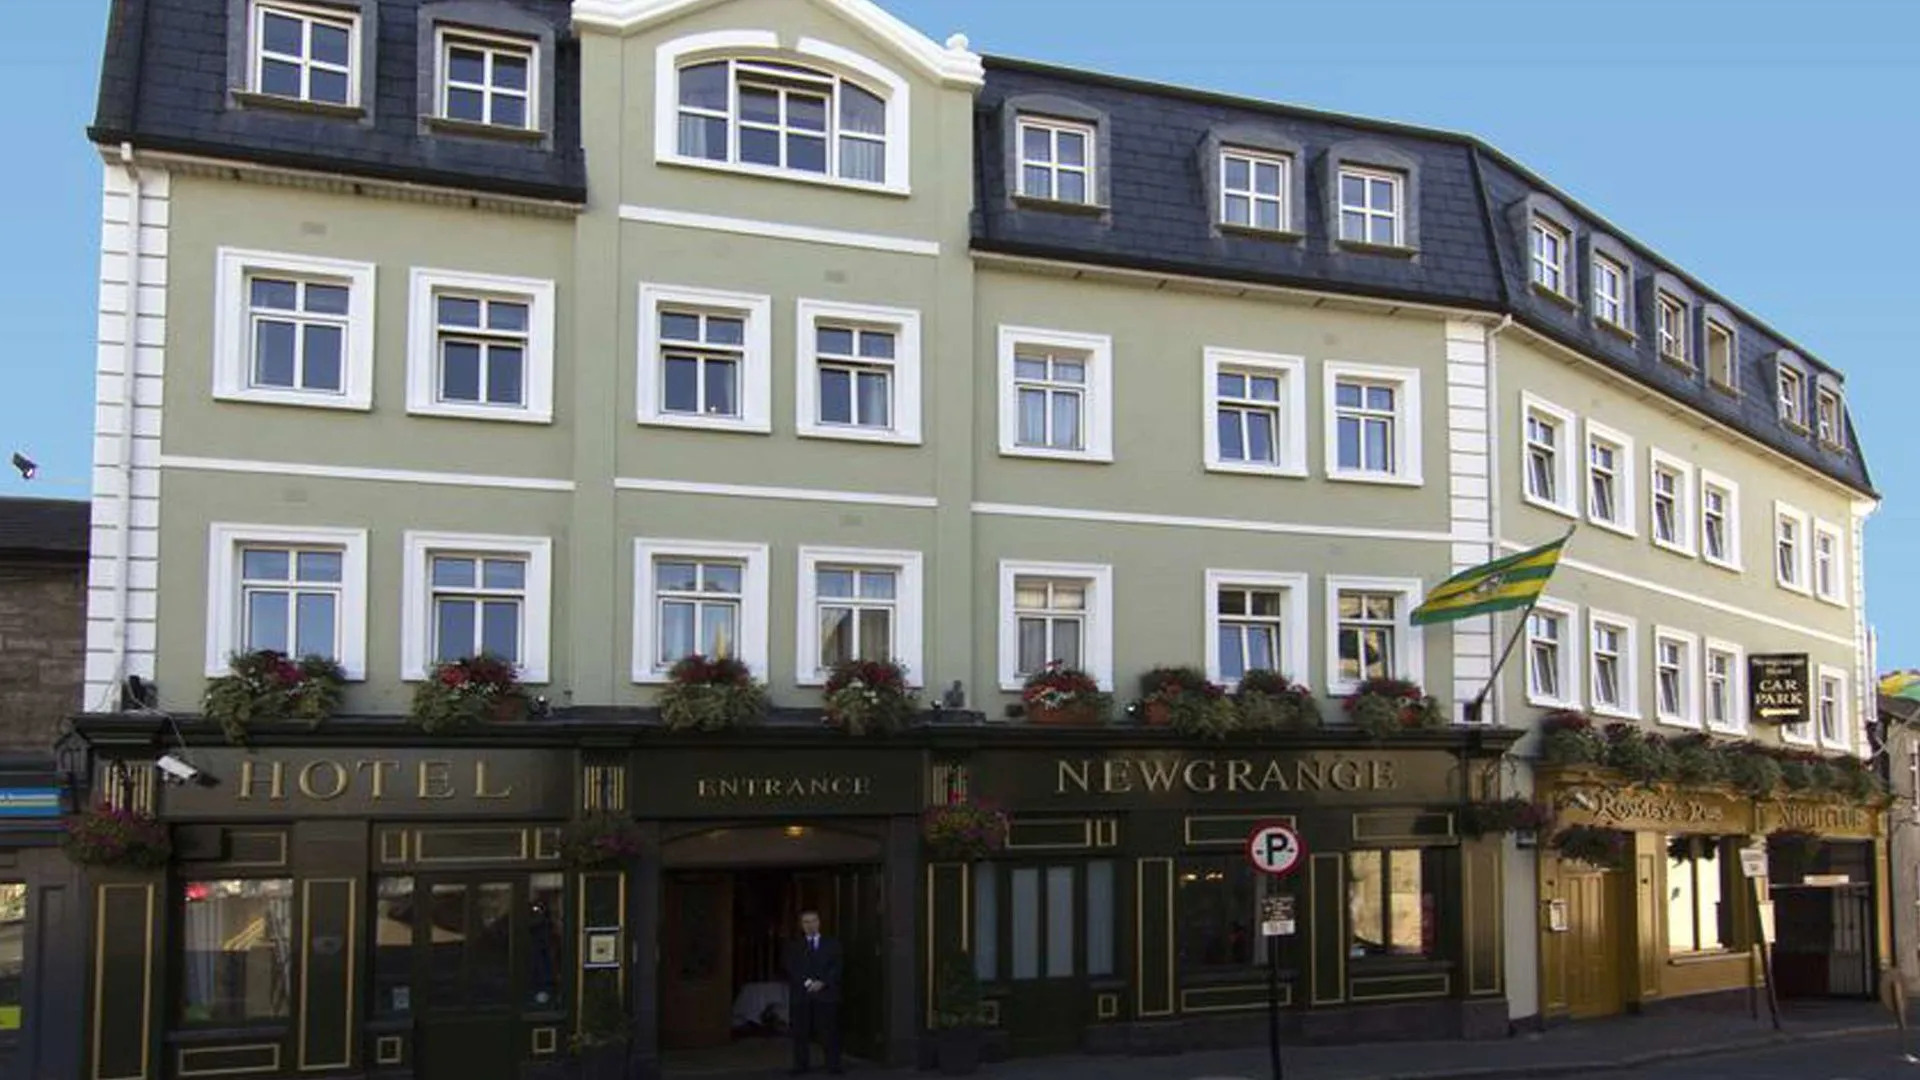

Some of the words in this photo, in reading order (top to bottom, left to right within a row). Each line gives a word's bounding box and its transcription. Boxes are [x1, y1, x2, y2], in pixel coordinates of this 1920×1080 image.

[1759, 679, 1799, 692] CAR
[1755, 693, 1803, 704] PARK
[238, 759, 512, 800] HOTEL
[1055, 759, 1397, 793] NEWGRANGE
[698, 777, 871, 797] ENTRANCE
